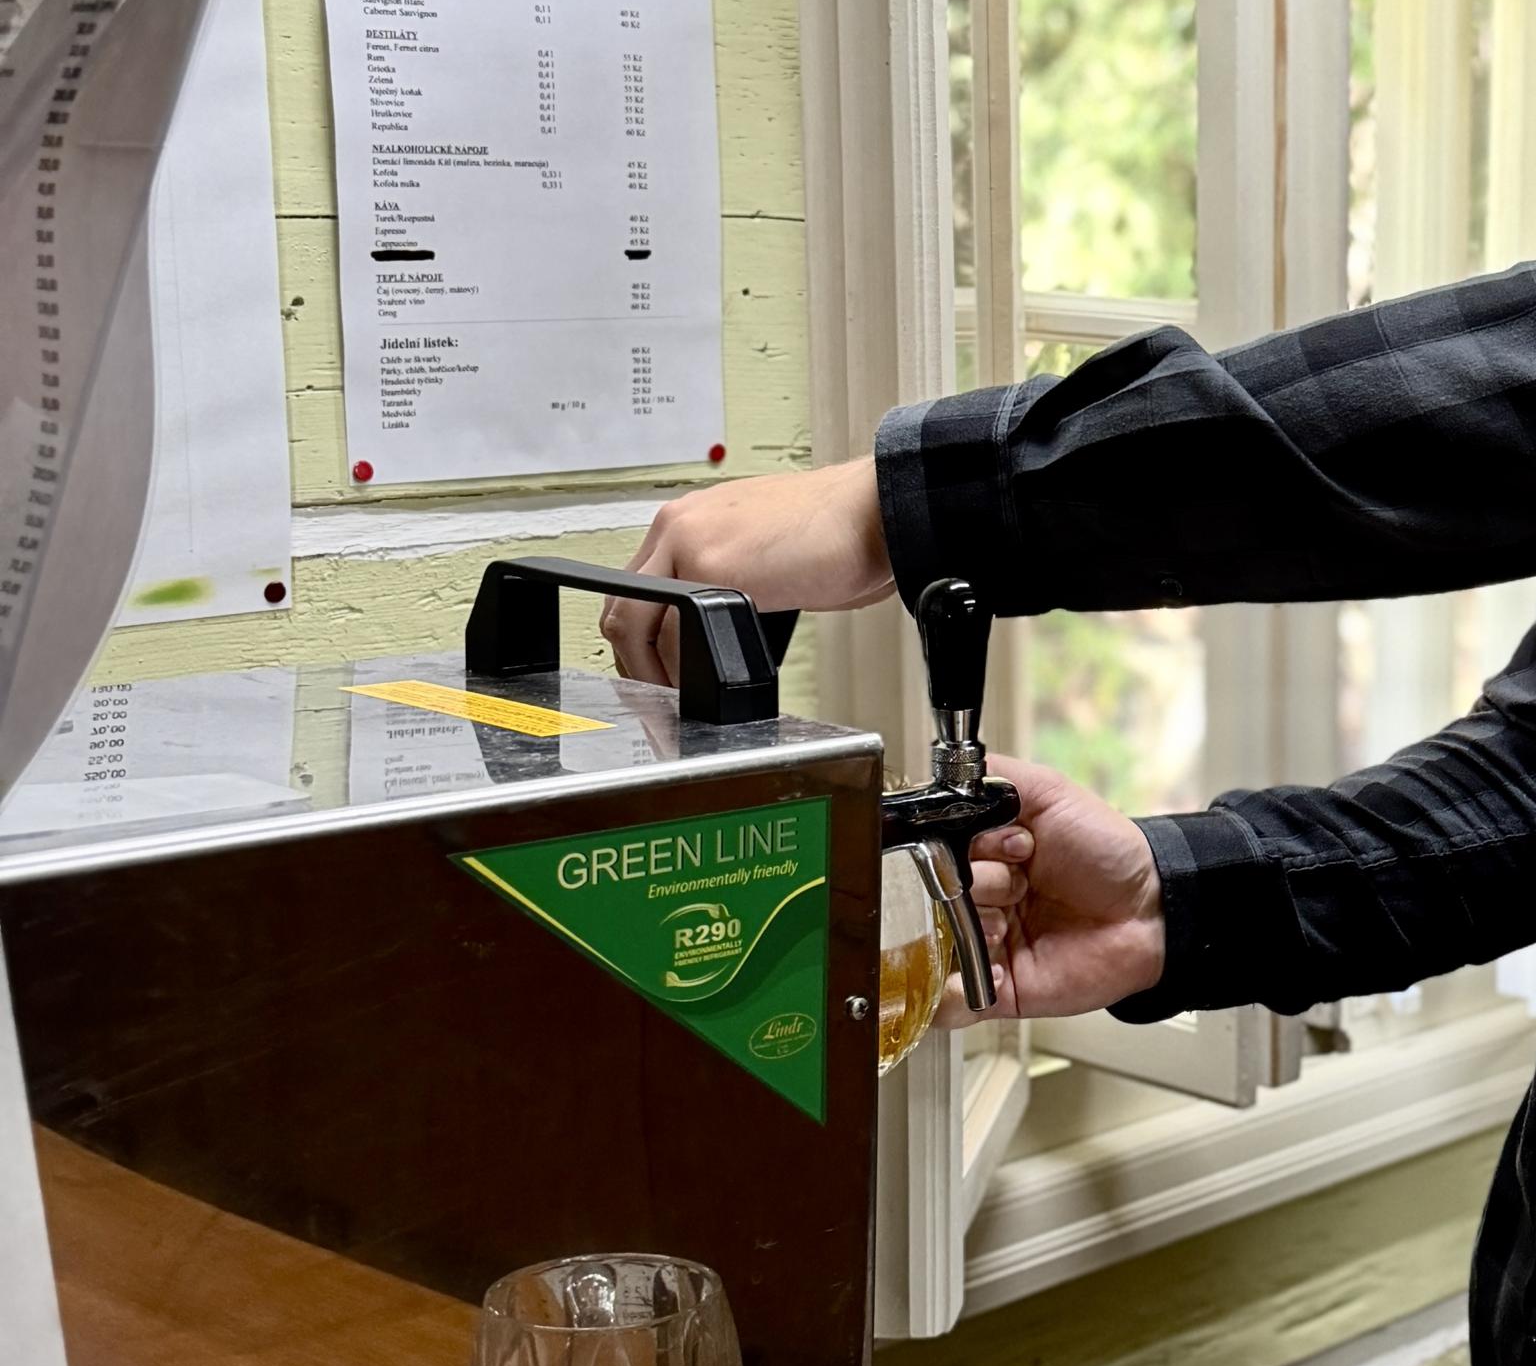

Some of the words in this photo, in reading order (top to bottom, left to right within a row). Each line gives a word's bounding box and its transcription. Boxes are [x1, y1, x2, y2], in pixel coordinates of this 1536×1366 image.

[364, 7, 397, 16] Cabernet
[400, 8, 437, 19] Sauvignon
[366, 29, 418, 40] DESTILÁTY
[367, 53, 384, 61] Rum
[369, 76, 393, 84] Zelená
[370, 98, 404, 106] Slivovice
[372, 122, 408, 132] Republica
[372, 144, 453, 154] NEALKOHOLICKÉ
[455, 145, 489, 155] NÁPOJE
[403, 158, 435, 166] limonáda
[373, 180, 398, 188] Kofola
[375, 200, 400, 211] KÁVA
[375, 227, 406, 236] Espresso
[375, 240, 418, 248] Cappuccino
[376, 273, 406, 283] TEPLÉ
[408, 272, 443, 282] NÁPOJE
[381, 338, 420, 349] Jídelní
[424, 337, 458, 348] lístek:
[557, 833, 702, 890] GREEN
[716, 817, 798, 863] LINE
[648, 870, 751, 899] Environmentally
[752, 860, 800, 880] friendly
[675, 918, 741, 949] R290
[763, 1017, 803, 1040] Lindr
